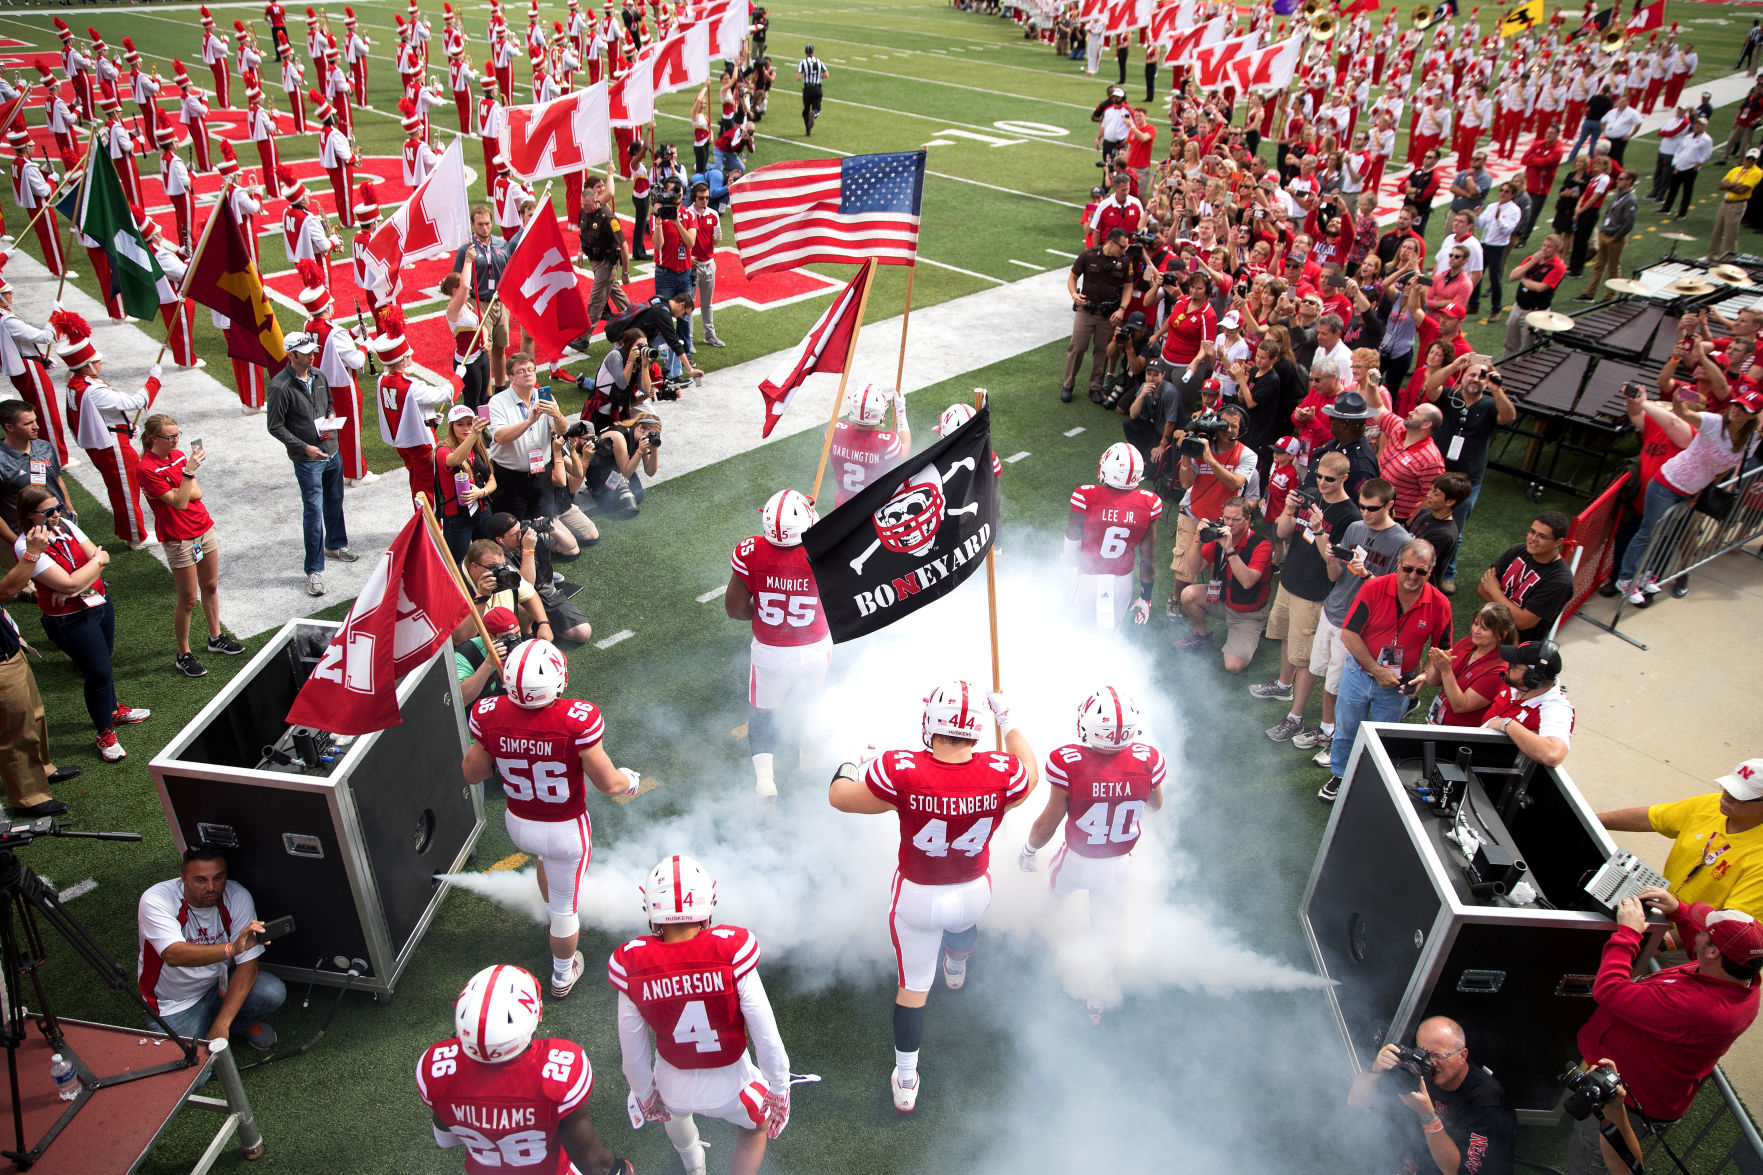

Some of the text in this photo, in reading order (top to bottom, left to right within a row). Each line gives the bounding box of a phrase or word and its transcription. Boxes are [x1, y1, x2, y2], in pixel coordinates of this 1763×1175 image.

[832, 444, 880, 464] DARLINGTON
[843, 461, 865, 493] 2
[1102, 508, 1137, 524] LEE JR.
[740, 537, 755, 557] 55
[1100, 526, 1131, 559] 6
[766, 575, 809, 591] MAURICE
[853, 523, 992, 618] BONEYARD
[758, 591, 818, 628] 55
[567, 701, 594, 722] 56
[949, 713, 975, 730] 44
[499, 737, 553, 756] SIMPSON
[495, 757, 570, 804] 56
[1092, 781, 1132, 797] BETKA
[910, 793, 998, 816] STOLTENBERG
[912, 816, 994, 858] 44
[1075, 800, 1145, 845] 40
[683, 891, 694, 907] 4
[642, 971, 725, 1001] ANDERSON
[672, 1000, 722, 1053] 4
[431, 1043, 459, 1078] 26
[542, 1048, 576, 1083] 26
[451, 1103, 536, 1129] WILLIAMS
[448, 1125, 548, 1167] 26
